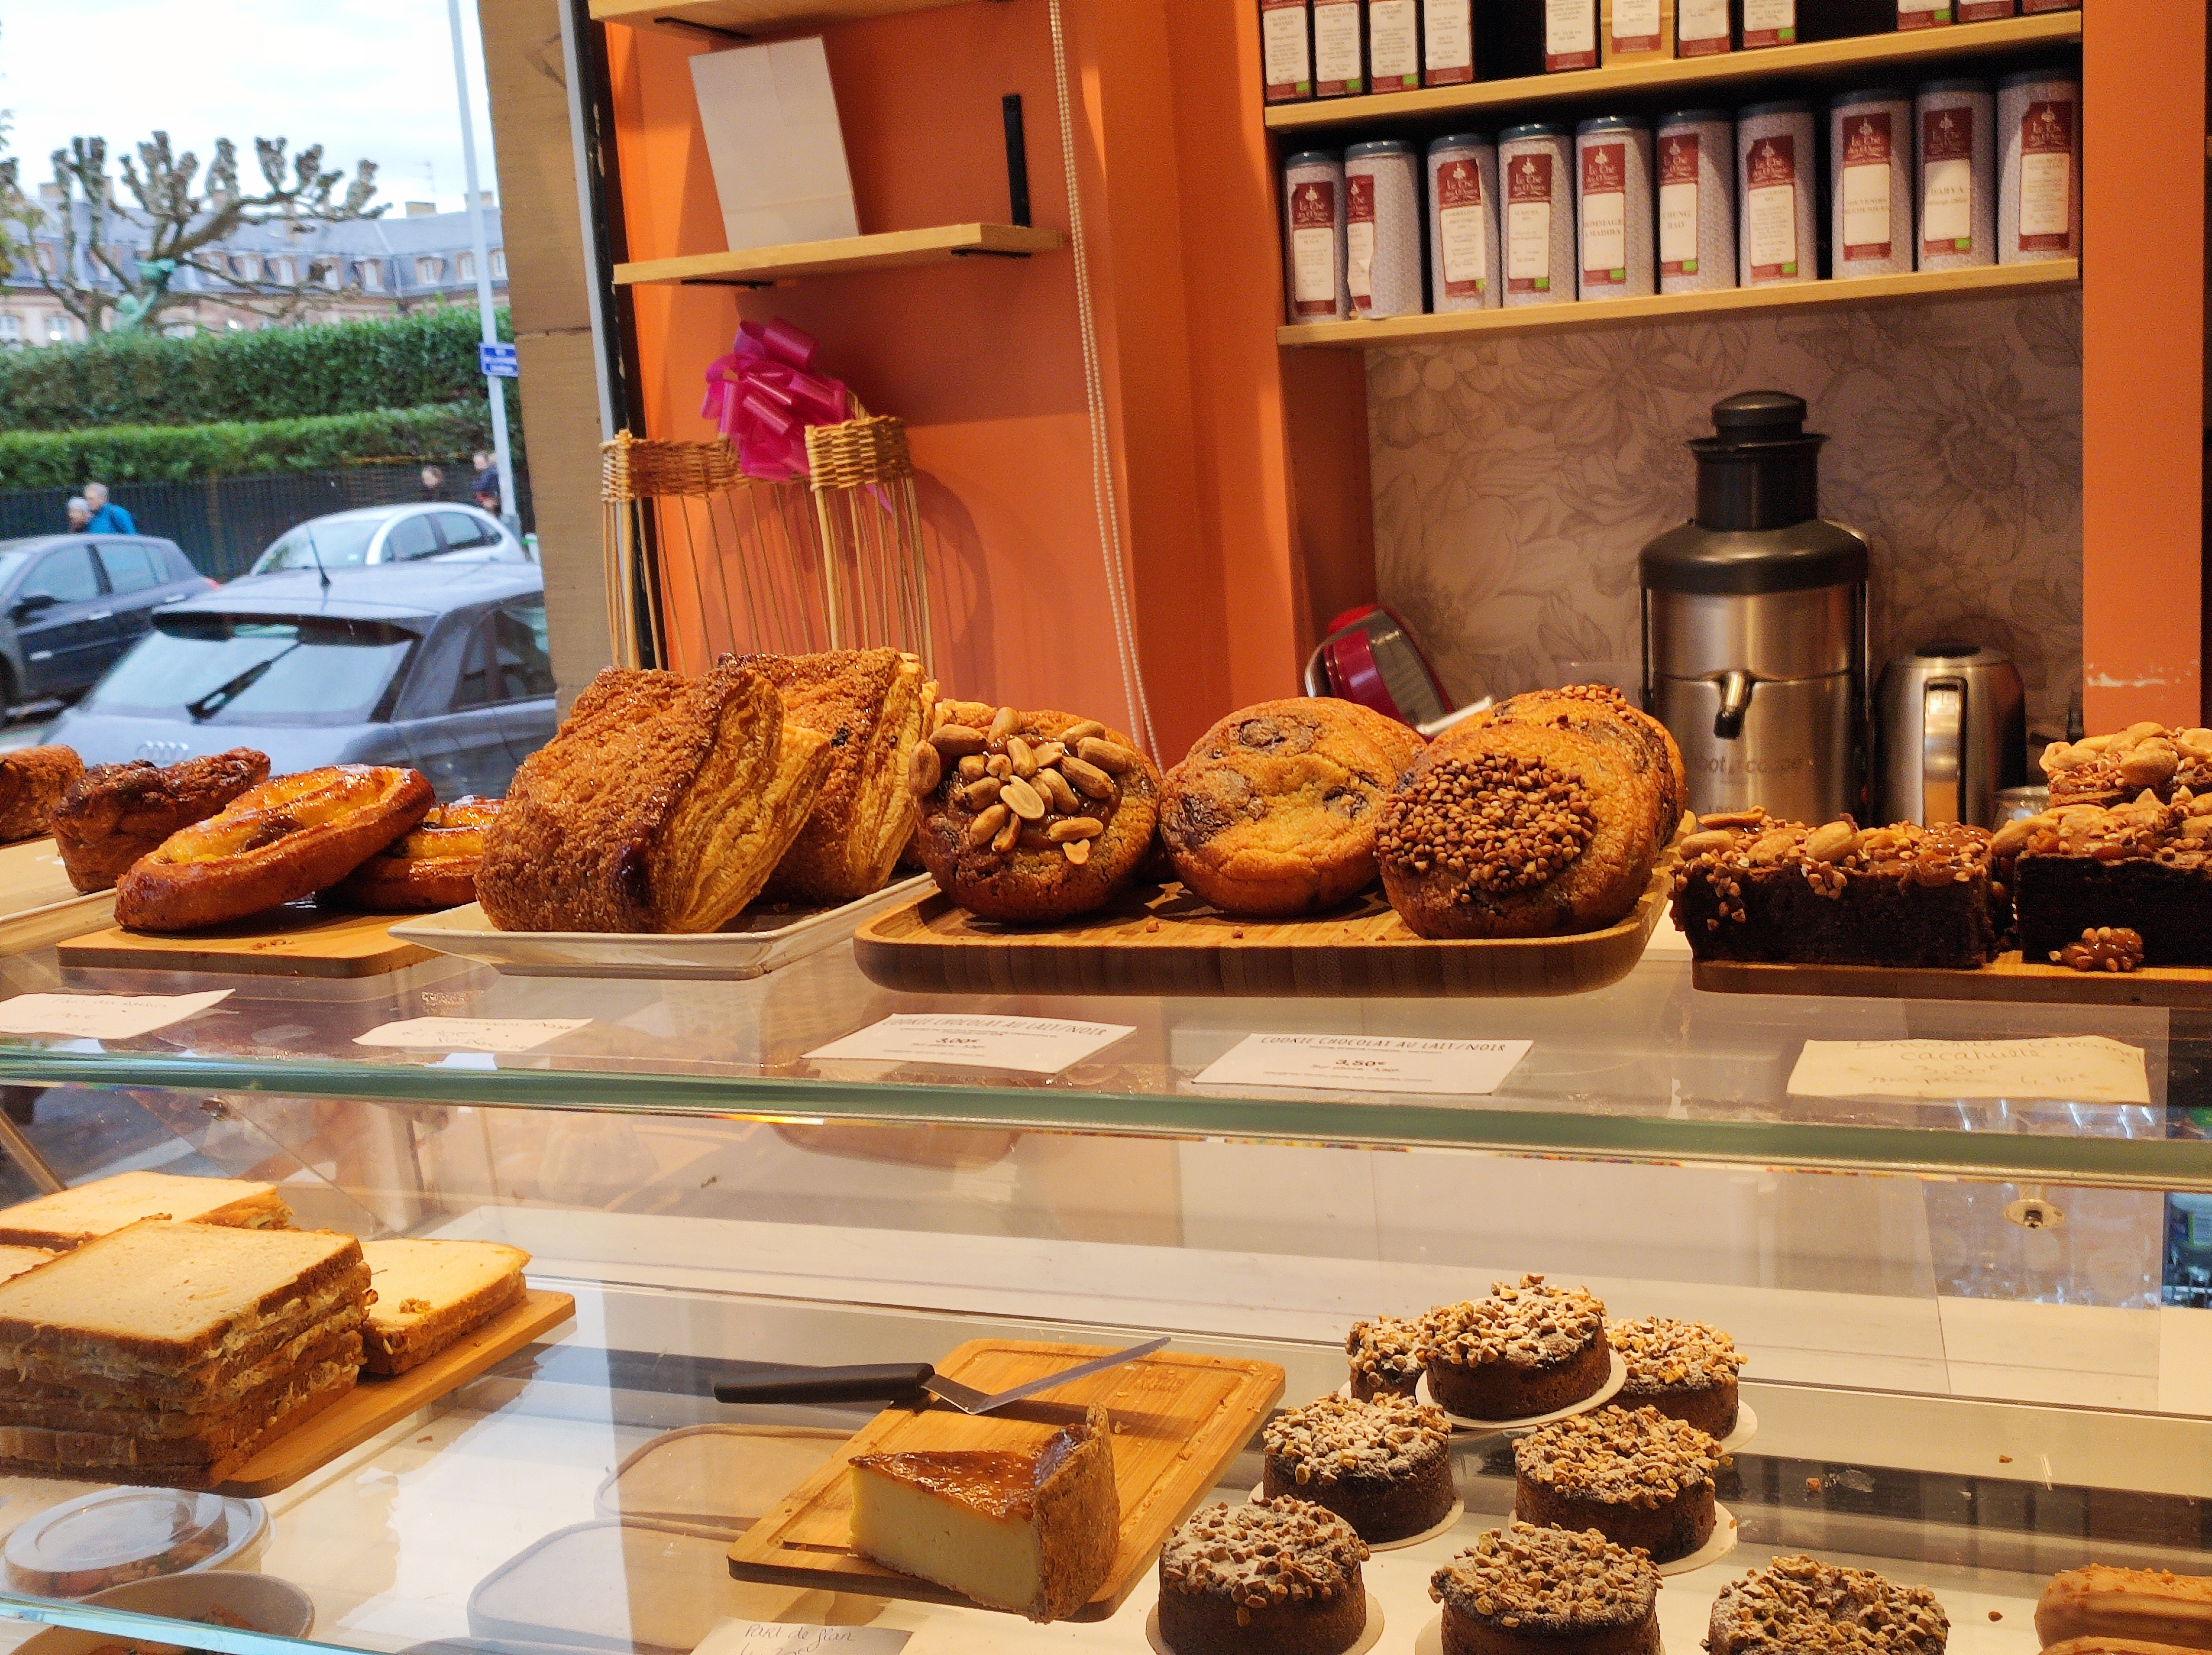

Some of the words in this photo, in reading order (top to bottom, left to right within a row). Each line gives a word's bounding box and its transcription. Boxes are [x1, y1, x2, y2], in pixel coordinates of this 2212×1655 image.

[933, 1018, 1003, 1027] CHOCOLAT
[1005, 1020, 1024, 1029] AU
[1261, 1036, 1313, 1044] COOKIE
[1319, 1037, 1391, 1048] CHOCOLAT
[1397, 1041, 1419, 1049] AU
[1421, 1042, 1506, 1052] LAIT/NOIR
[788, 1626, 809, 1640] de
